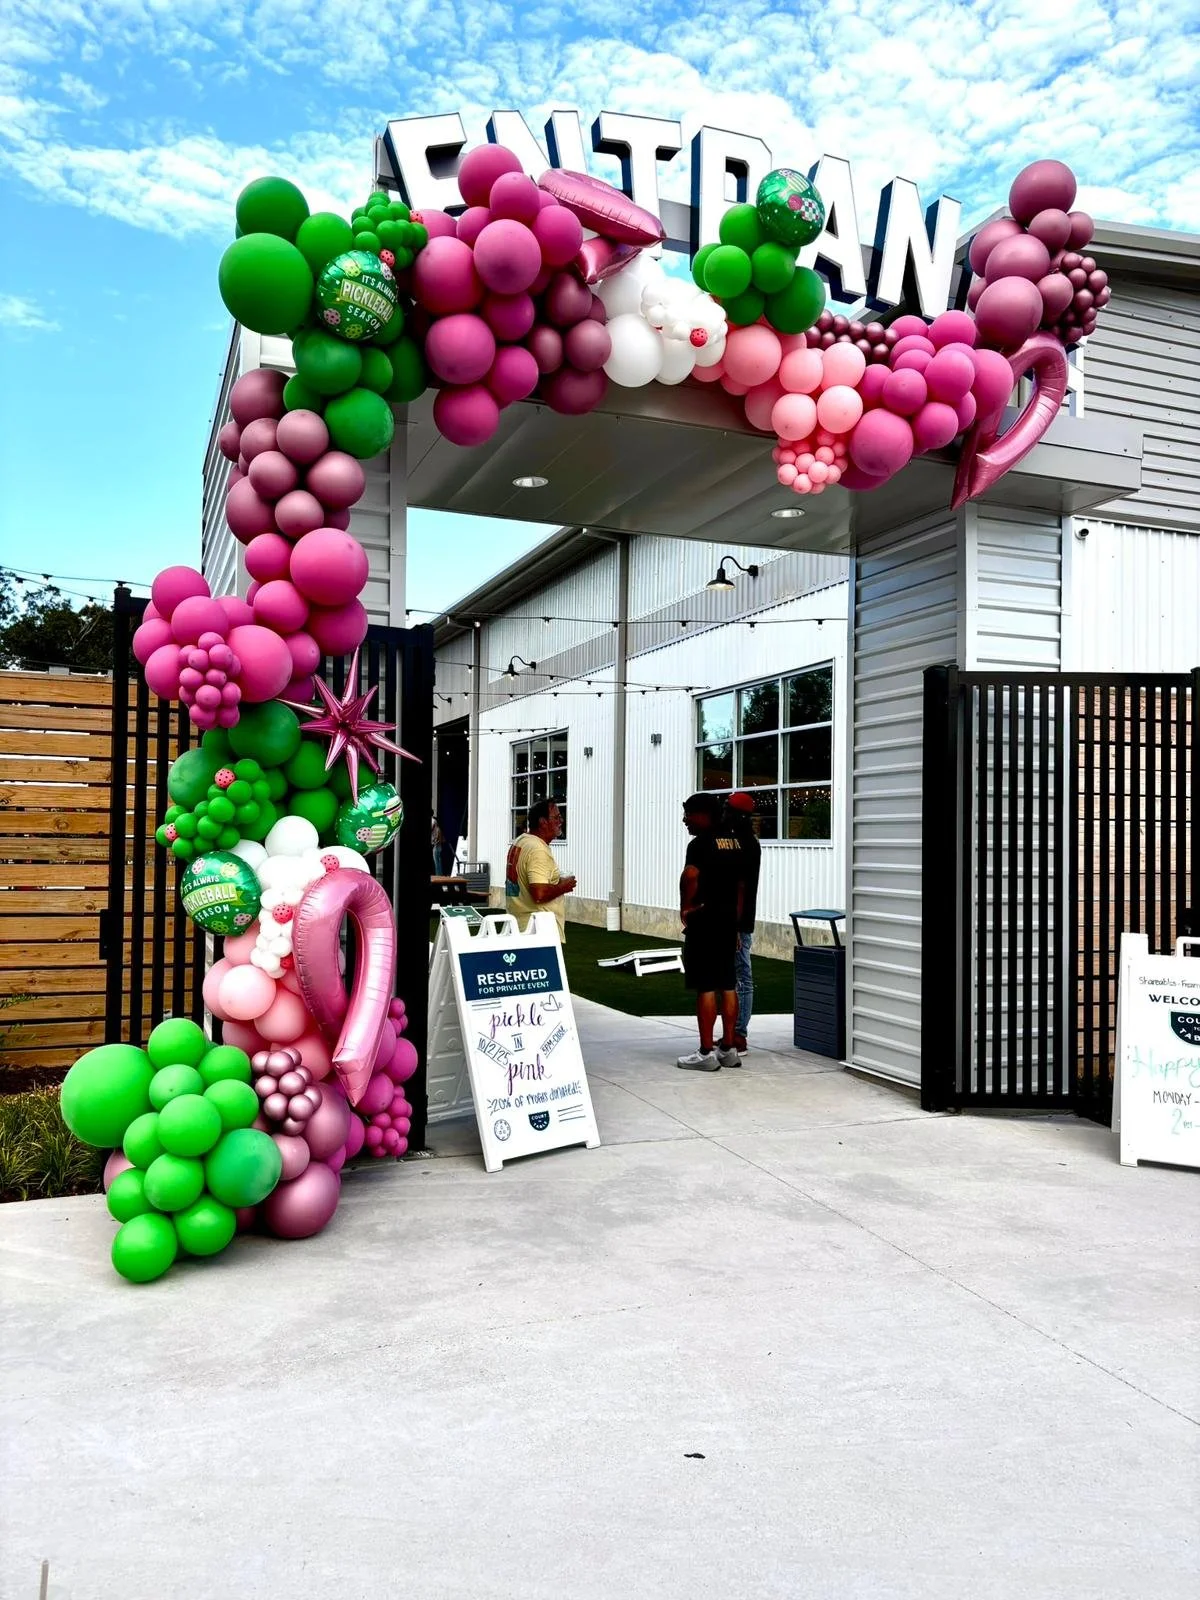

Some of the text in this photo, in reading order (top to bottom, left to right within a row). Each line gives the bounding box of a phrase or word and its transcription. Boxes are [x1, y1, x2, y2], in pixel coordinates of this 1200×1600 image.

[384, 109, 964, 320] ENTRAN
[347, 305, 381, 330] SEASON
[192, 875, 220, 887] ALWAYS
[195, 904, 230, 922] SEASON
[477, 968, 548, 986] RESERVED
[478, 981, 550, 995] FOR PRIVATE EVENT
[1148, 993, 1200, 1007] WELCO
[489, 1002, 545, 1040] pickle
[1177, 1016, 1200, 1025] COU
[1179, 1028, 1200, 1042] TAB
[504, 1053, 553, 1096] pink
[1153, 1090, 1192, 1106] MONDAY
